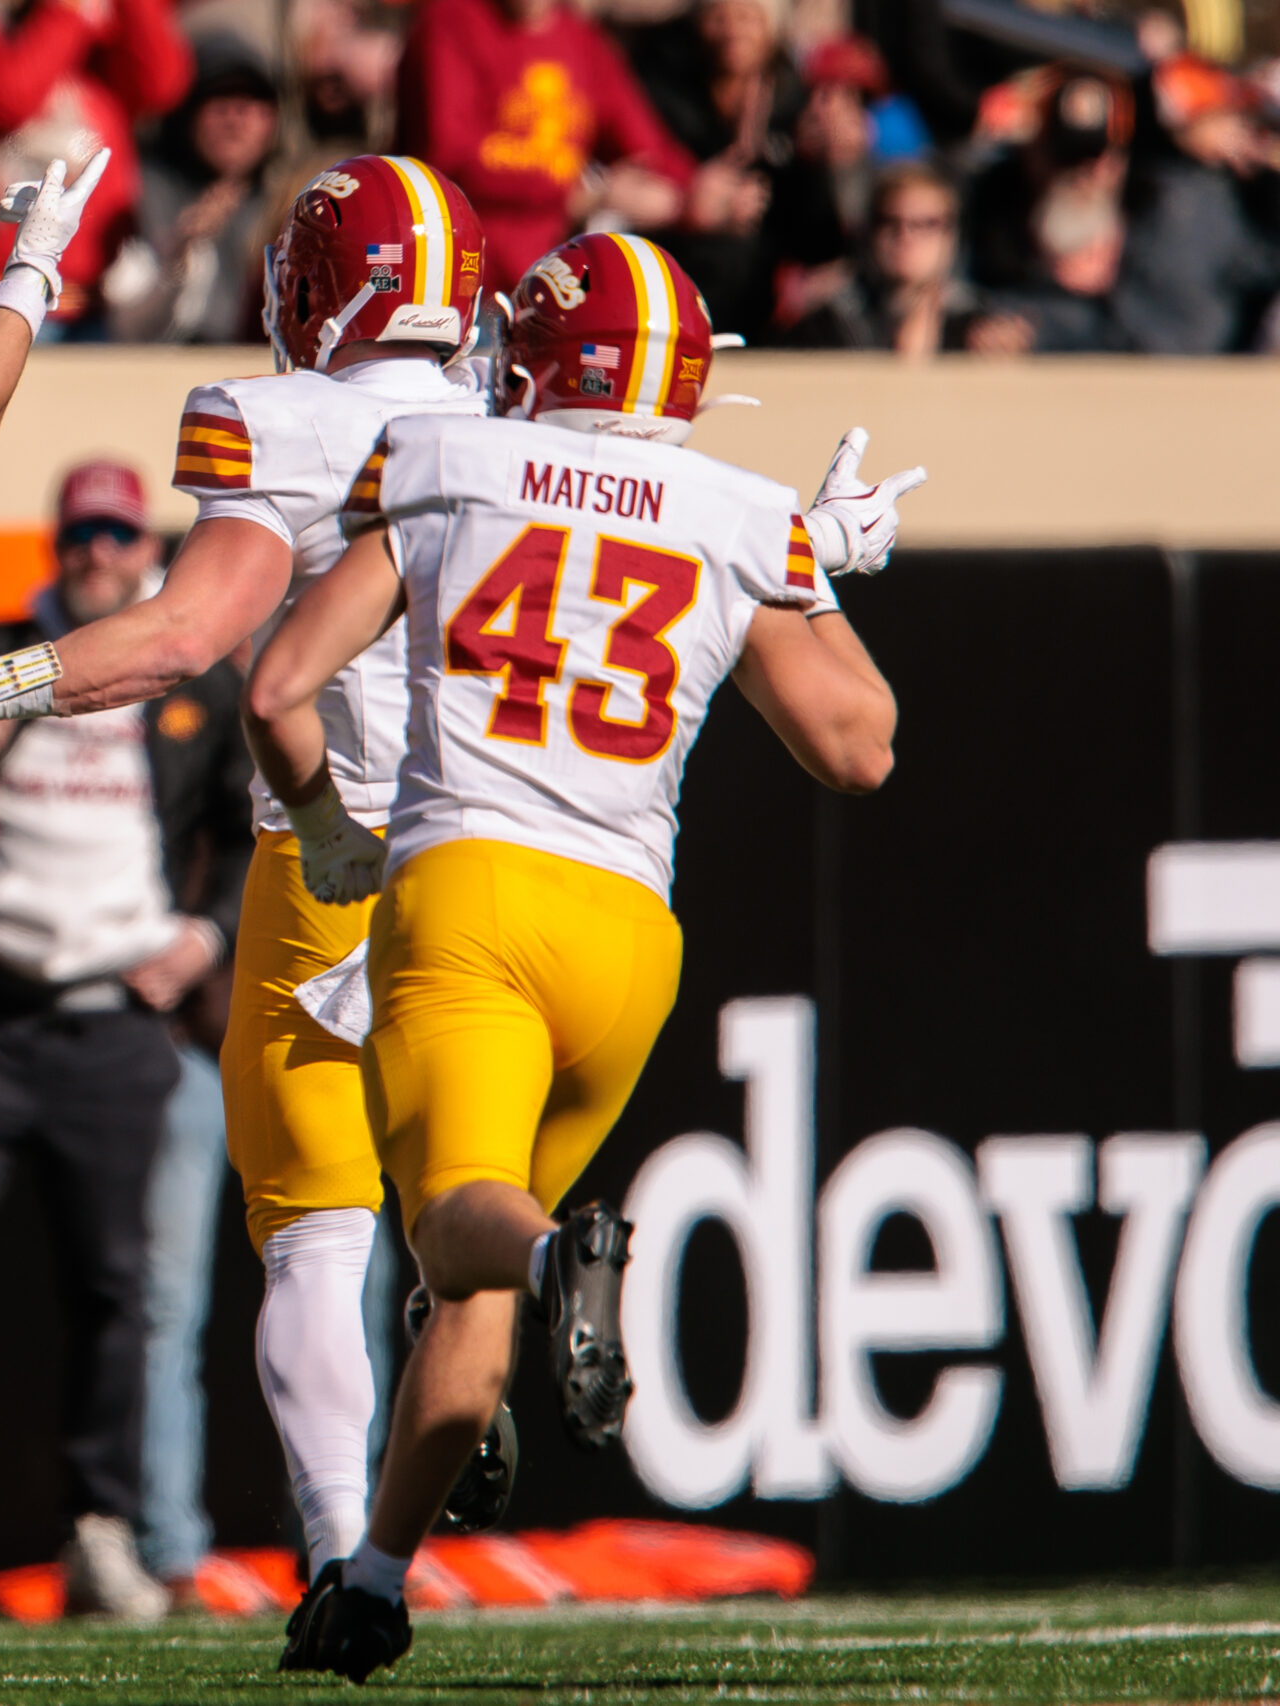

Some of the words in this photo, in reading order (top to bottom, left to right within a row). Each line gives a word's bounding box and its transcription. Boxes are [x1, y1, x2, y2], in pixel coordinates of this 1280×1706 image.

[374, 278, 389, 290] AE
[583, 379, 601, 392] AE
[520, 460, 664, 524] MATSON
[443, 521, 703, 765] 43
